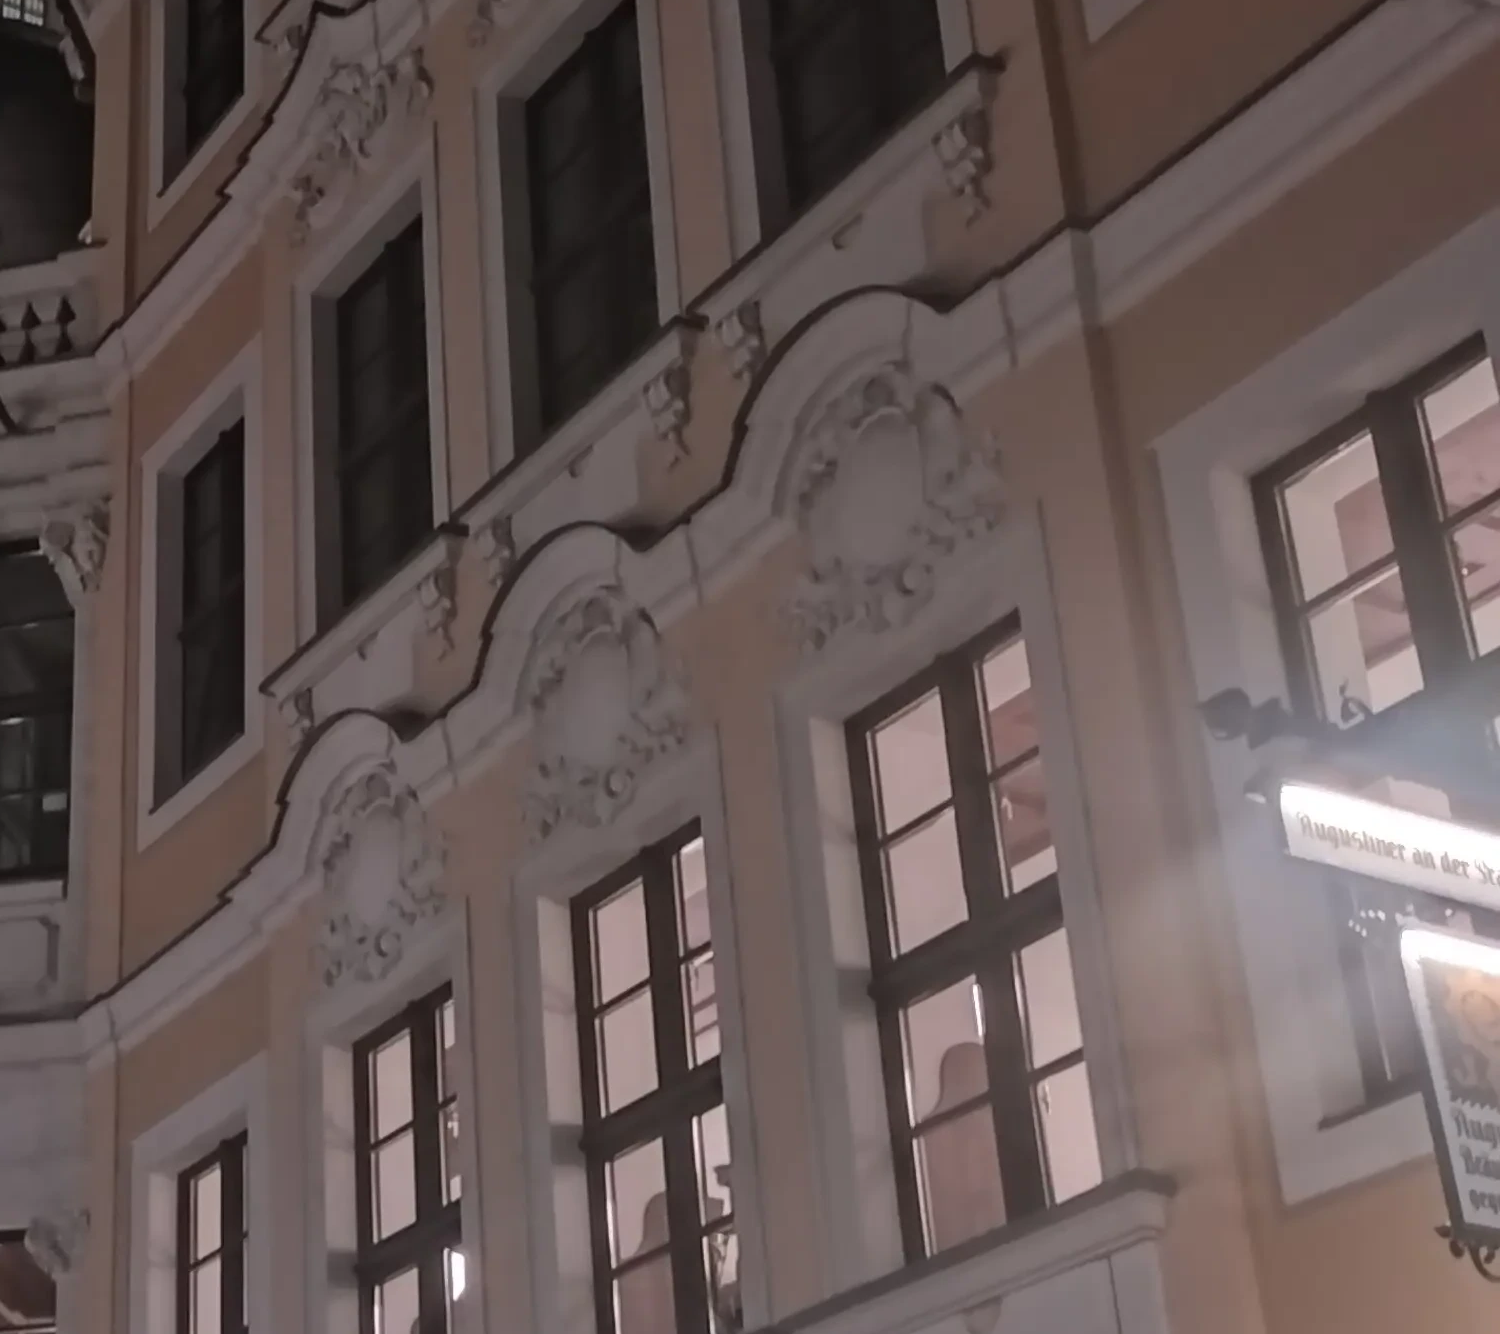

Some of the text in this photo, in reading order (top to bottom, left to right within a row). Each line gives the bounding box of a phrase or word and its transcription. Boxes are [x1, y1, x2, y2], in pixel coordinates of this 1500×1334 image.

[1296, 811, 1405, 863] Augustiner
[1412, 847, 1437, 871] an
[1440, 850, 1470, 879] der
[1450, 1107, 1500, 1149] Aug
